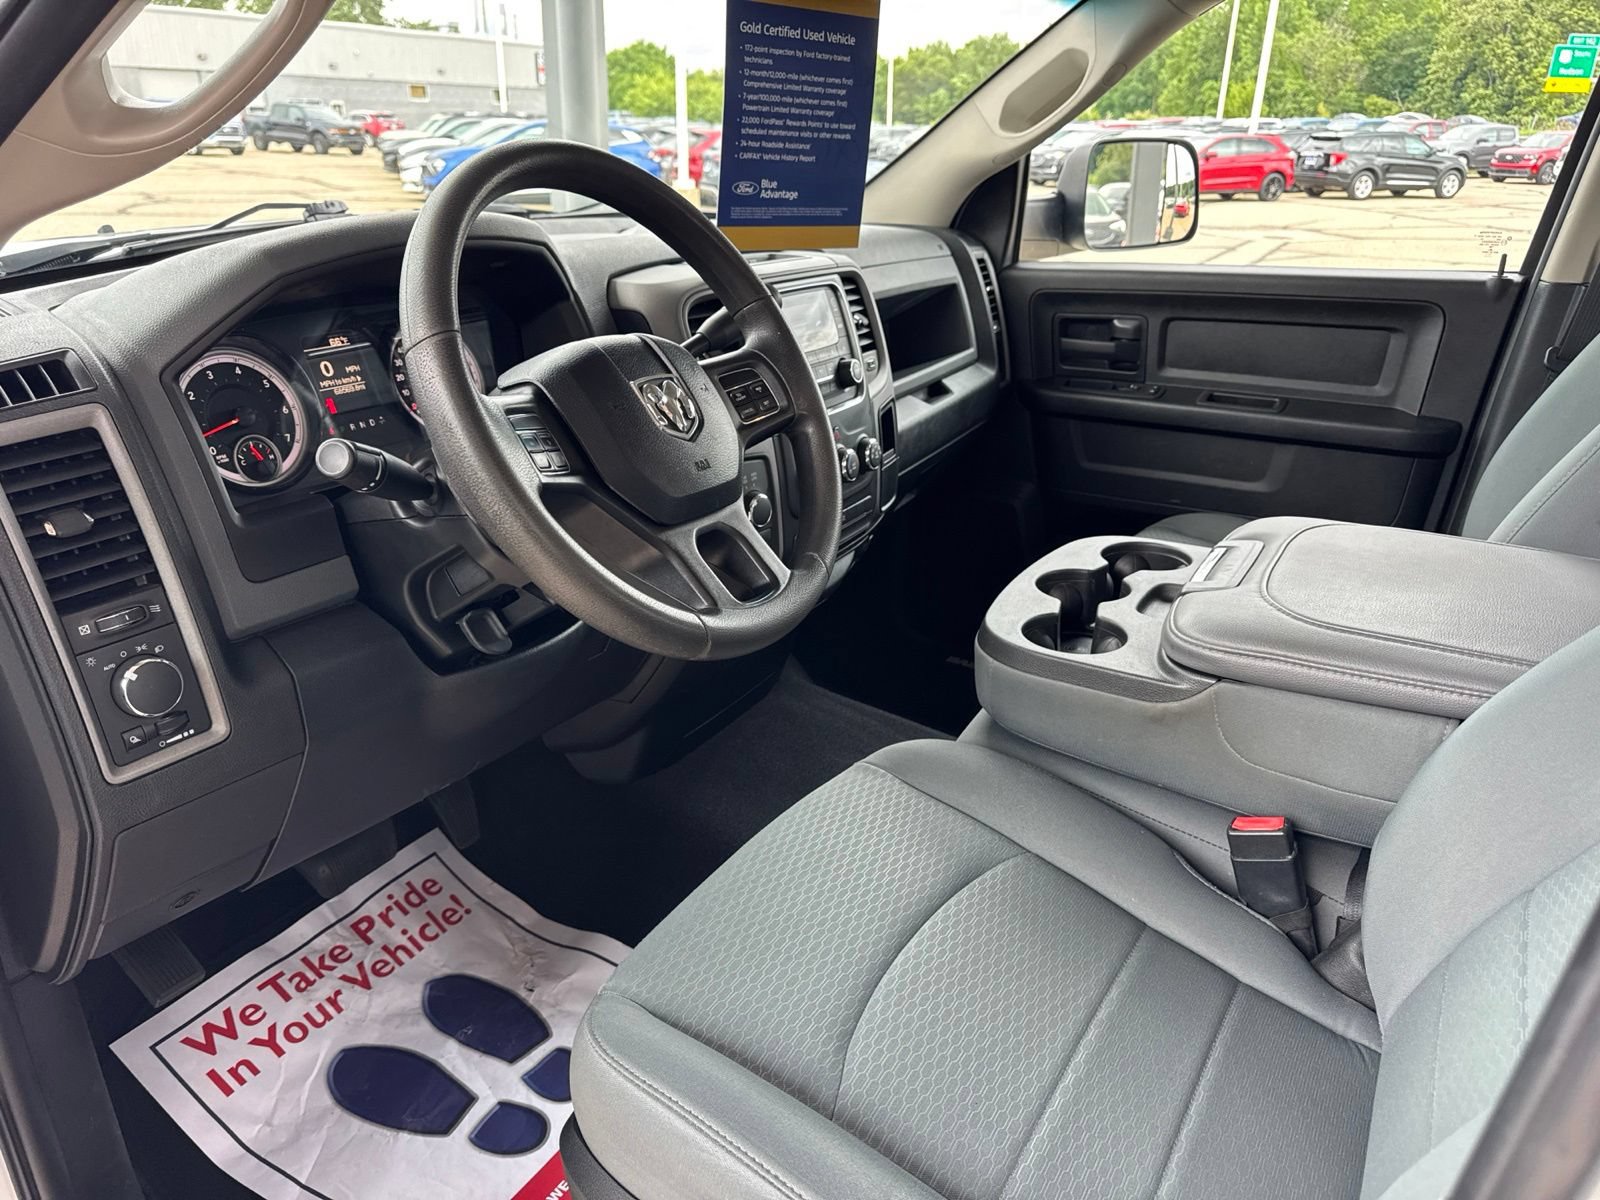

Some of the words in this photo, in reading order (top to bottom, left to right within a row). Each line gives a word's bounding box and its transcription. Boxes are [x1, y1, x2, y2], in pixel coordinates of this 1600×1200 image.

[740, 21, 761, 35] Gold
[764, 24, 800, 39] Certified
[803, 28, 824, 42] Used
[827, 31, 856, 46] Vehicle
[769, 47, 795, 56] inspection
[796, 49, 802, 58] by
[804, 50, 815, 58] Ford
[744, 56, 773, 65] technicians
[826, 76, 841, 84] comes
[743, 80, 782, 91] Comprehensive
[783, 82, 802, 92] Limited
[803, 85, 824, 94] Warranty
[742, 104, 770, 112] Powertrain
[771, 105, 789, 114] Limited
[790, 107, 812, 116] Warranty
[786, 119, 806, 127] Rewards
[741, 128, 767, 136] scheduled
[768, 129, 799, 137] maintenance
[740, 140, 760, 148] 24-hour
[761, 141, 784, 149] Roadside
[781, 154, 799, 162] History
[799, 155, 816, 163] Report
[735, 182, 756, 194] Ford
[761, 179, 778, 189] Blue
[760, 190, 798, 200] Advantage
[235, 366, 242, 374] 4
[320, 361, 334, 377] 0
[345, 365, 361, 373] MPH
[206, 370, 214, 379] 3
[395, 374, 405, 382] 20
[263, 379, 270, 388] 5
[187, 391, 196, 400] 2
[282, 406, 289, 414] 6
[369, 418, 376, 426] D
[284, 434, 290, 442] 7
[209, 446, 216, 455] 0
[104, 663, 116, 671] AUTO
[180, 1002, 268, 1057] We
[256, 942, 353, 1004] Take
[350, 875, 444, 947] Pride
[205, 1058, 262, 1098] In
[248, 987, 345, 1059] Your
[338, 893, 473, 993] Vehicle!
